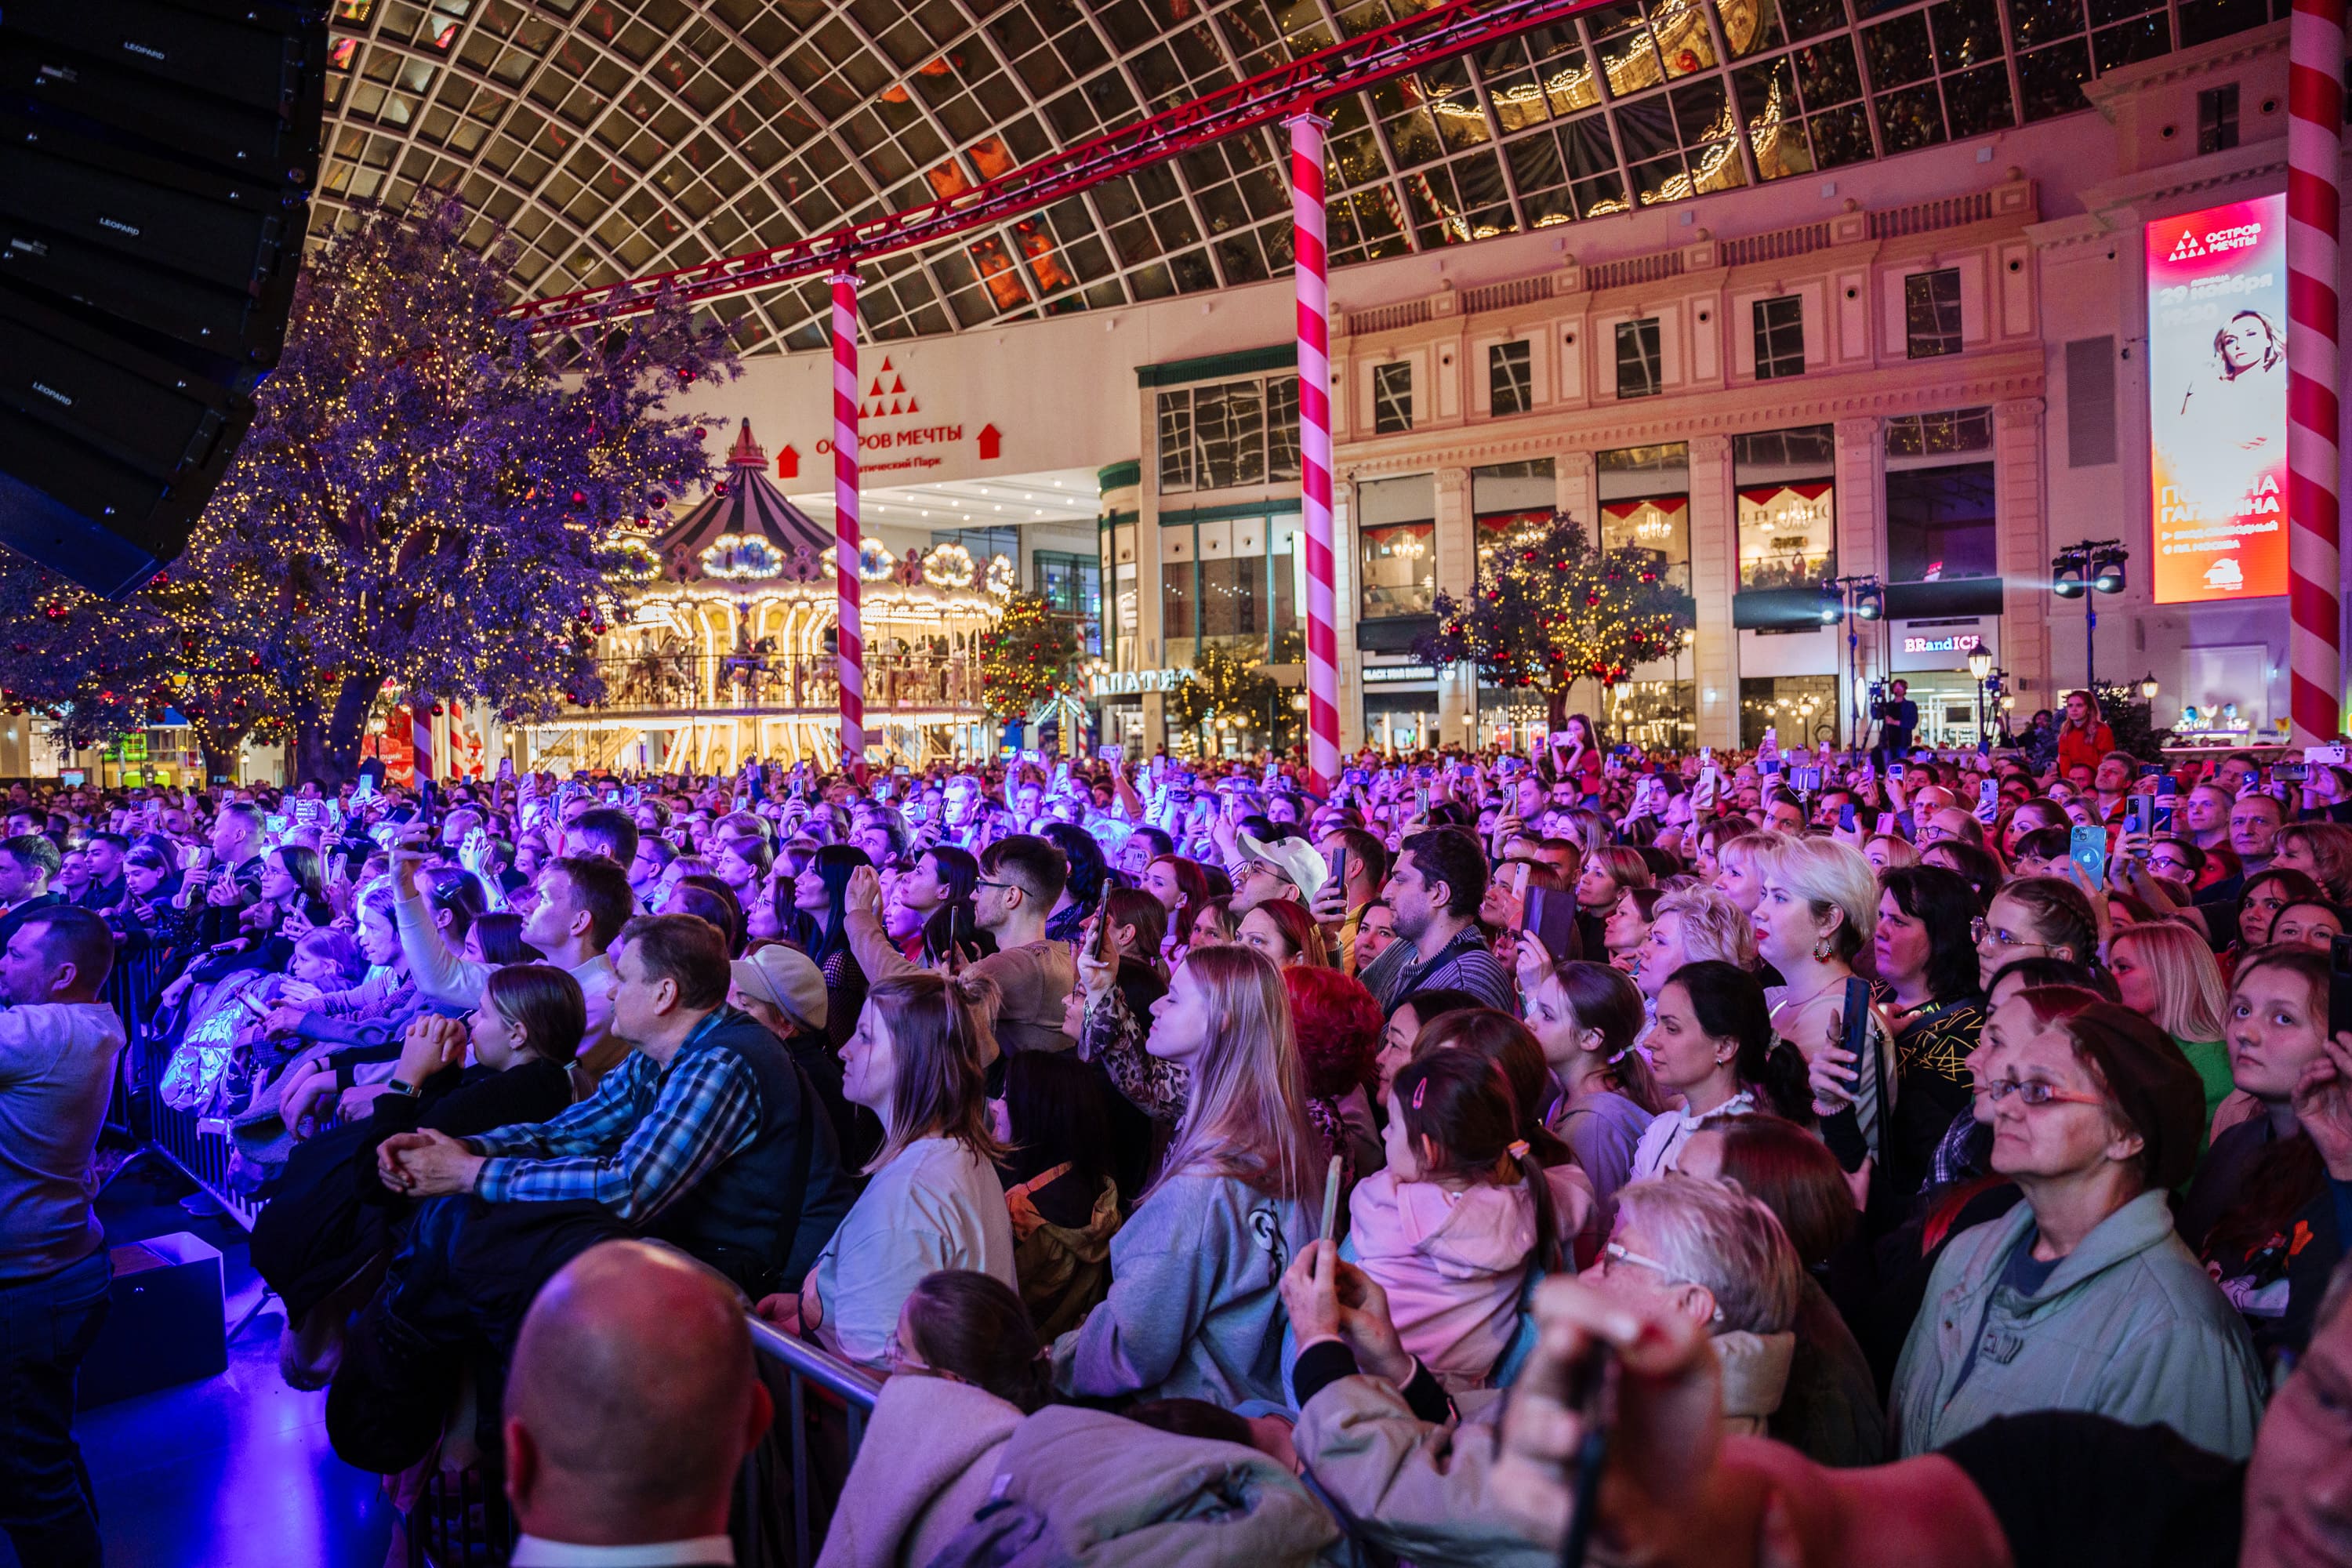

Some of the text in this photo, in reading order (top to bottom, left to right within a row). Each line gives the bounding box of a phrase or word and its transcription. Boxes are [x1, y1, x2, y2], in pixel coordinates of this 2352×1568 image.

[124, 42, 165, 60] LEOPARD
[100, 217, 140, 235] LEOPARD
[2205, 223, 2261, 243] ОСТРОВ
[2209, 234, 2257, 253] МЕЧТЫ
[2159, 285, 2188, 306] 29
[32, 381, 72, 405] LEOPARD
[896, 424, 963, 447] МЕЧТЫ
[913, 456, 942, 469] Парк
